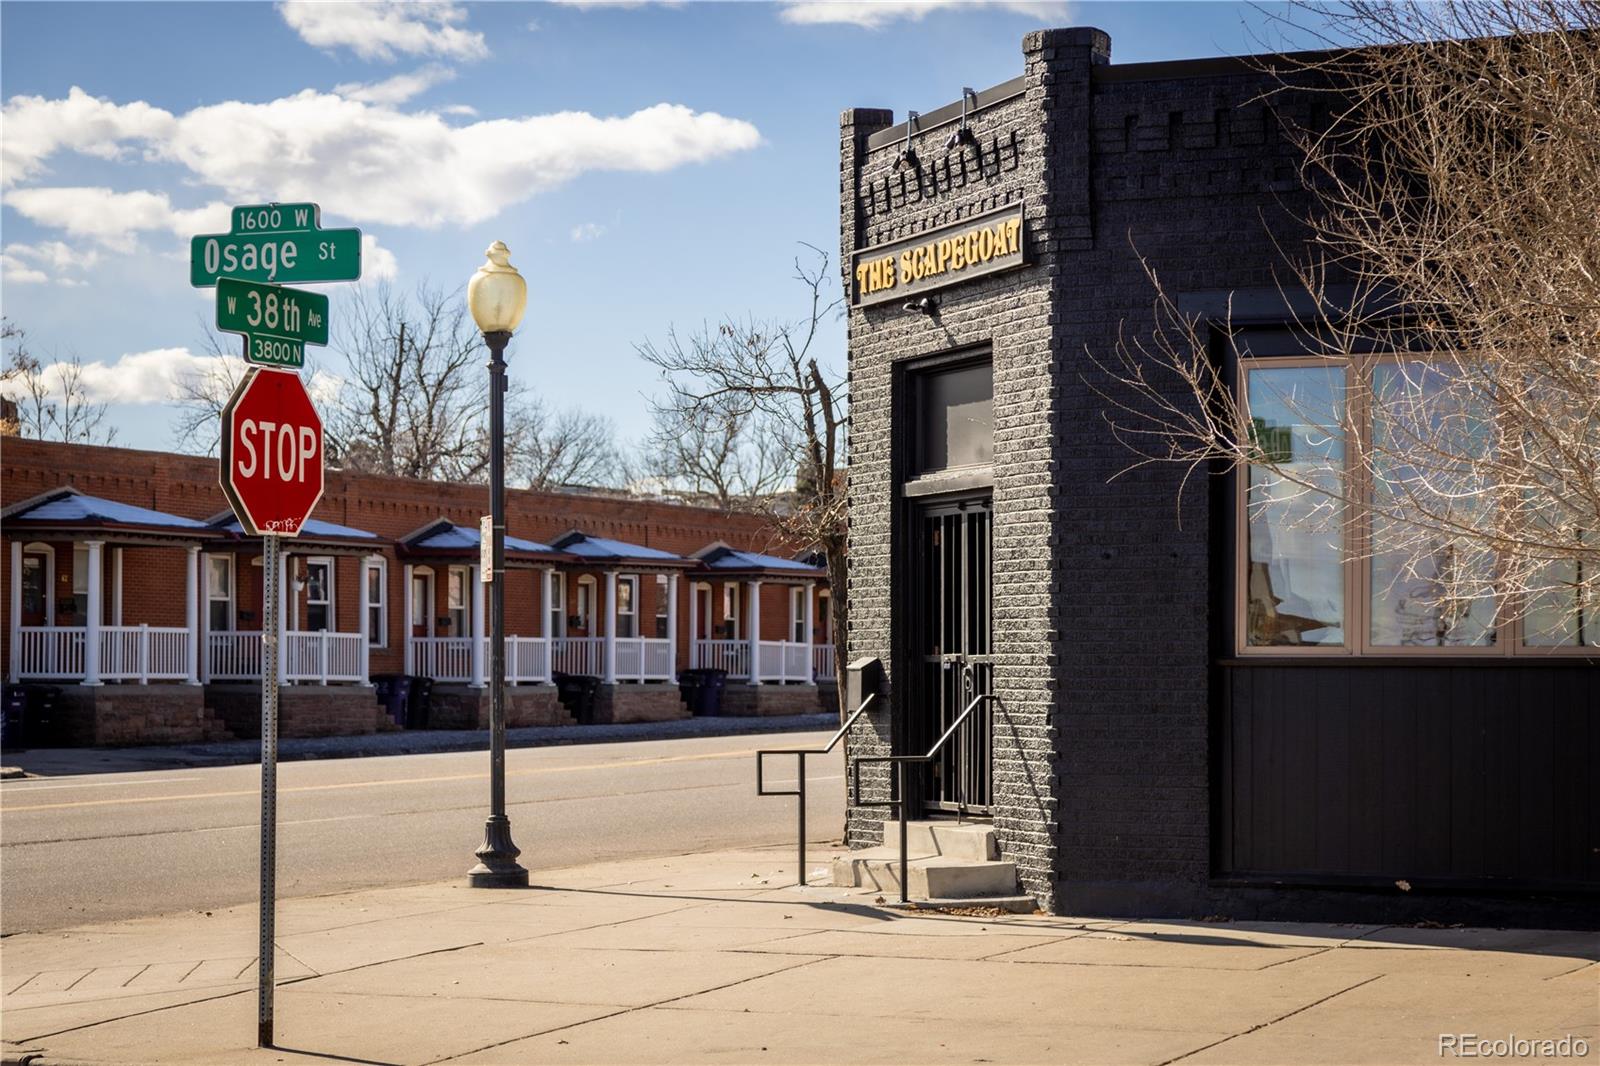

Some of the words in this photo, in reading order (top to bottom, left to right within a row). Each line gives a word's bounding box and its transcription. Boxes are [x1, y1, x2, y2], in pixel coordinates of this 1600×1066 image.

[240, 210, 282, 230] 1600
[295, 208, 309, 227] W
[204, 238, 298, 281] Osage
[318, 241, 337, 260] St
[856, 256, 896, 294] THE
[900, 217, 1021, 284] SCAPEGOAT
[227, 296, 237, 315] W
[246, 290, 301, 333] 38th
[307, 309, 322, 328] Ave
[254, 339, 291, 361] 3800
[292, 345, 302, 363] N
[238, 418, 317, 483] STOP
